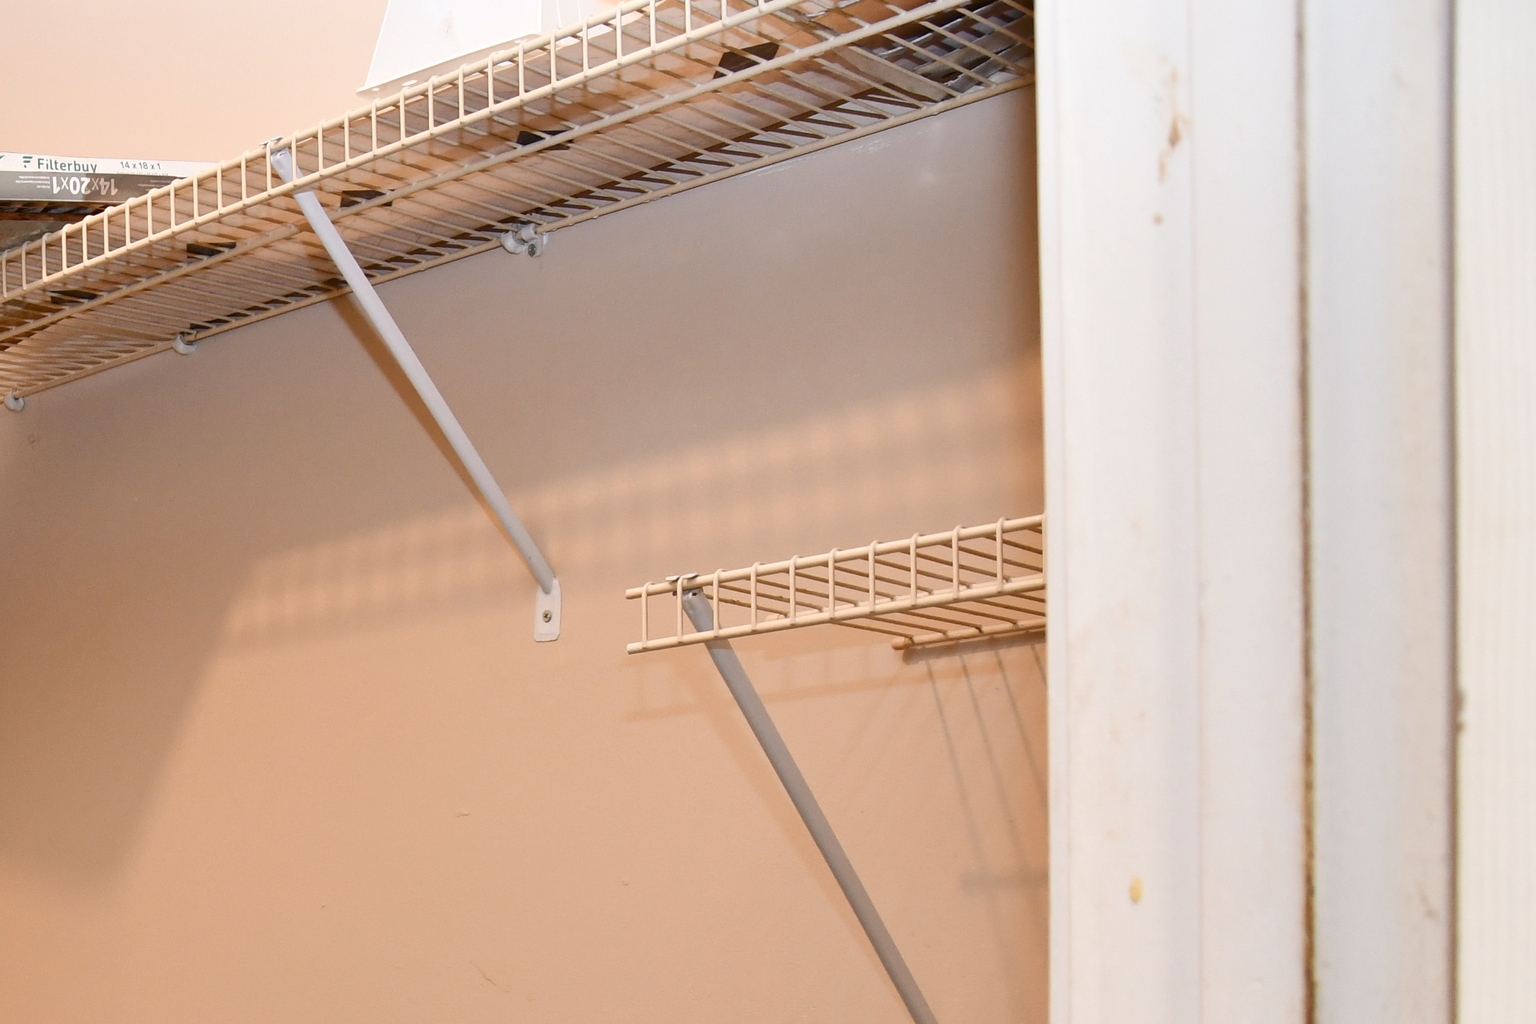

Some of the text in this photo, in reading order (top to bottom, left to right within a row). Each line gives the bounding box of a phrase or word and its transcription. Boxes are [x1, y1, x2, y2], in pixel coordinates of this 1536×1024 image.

[37, 158, 97, 173] Filterbuy
[120, 161, 130, 169] 14
[139, 162, 148, 170] 18
[52, 176, 119, 195] 14x20x1
